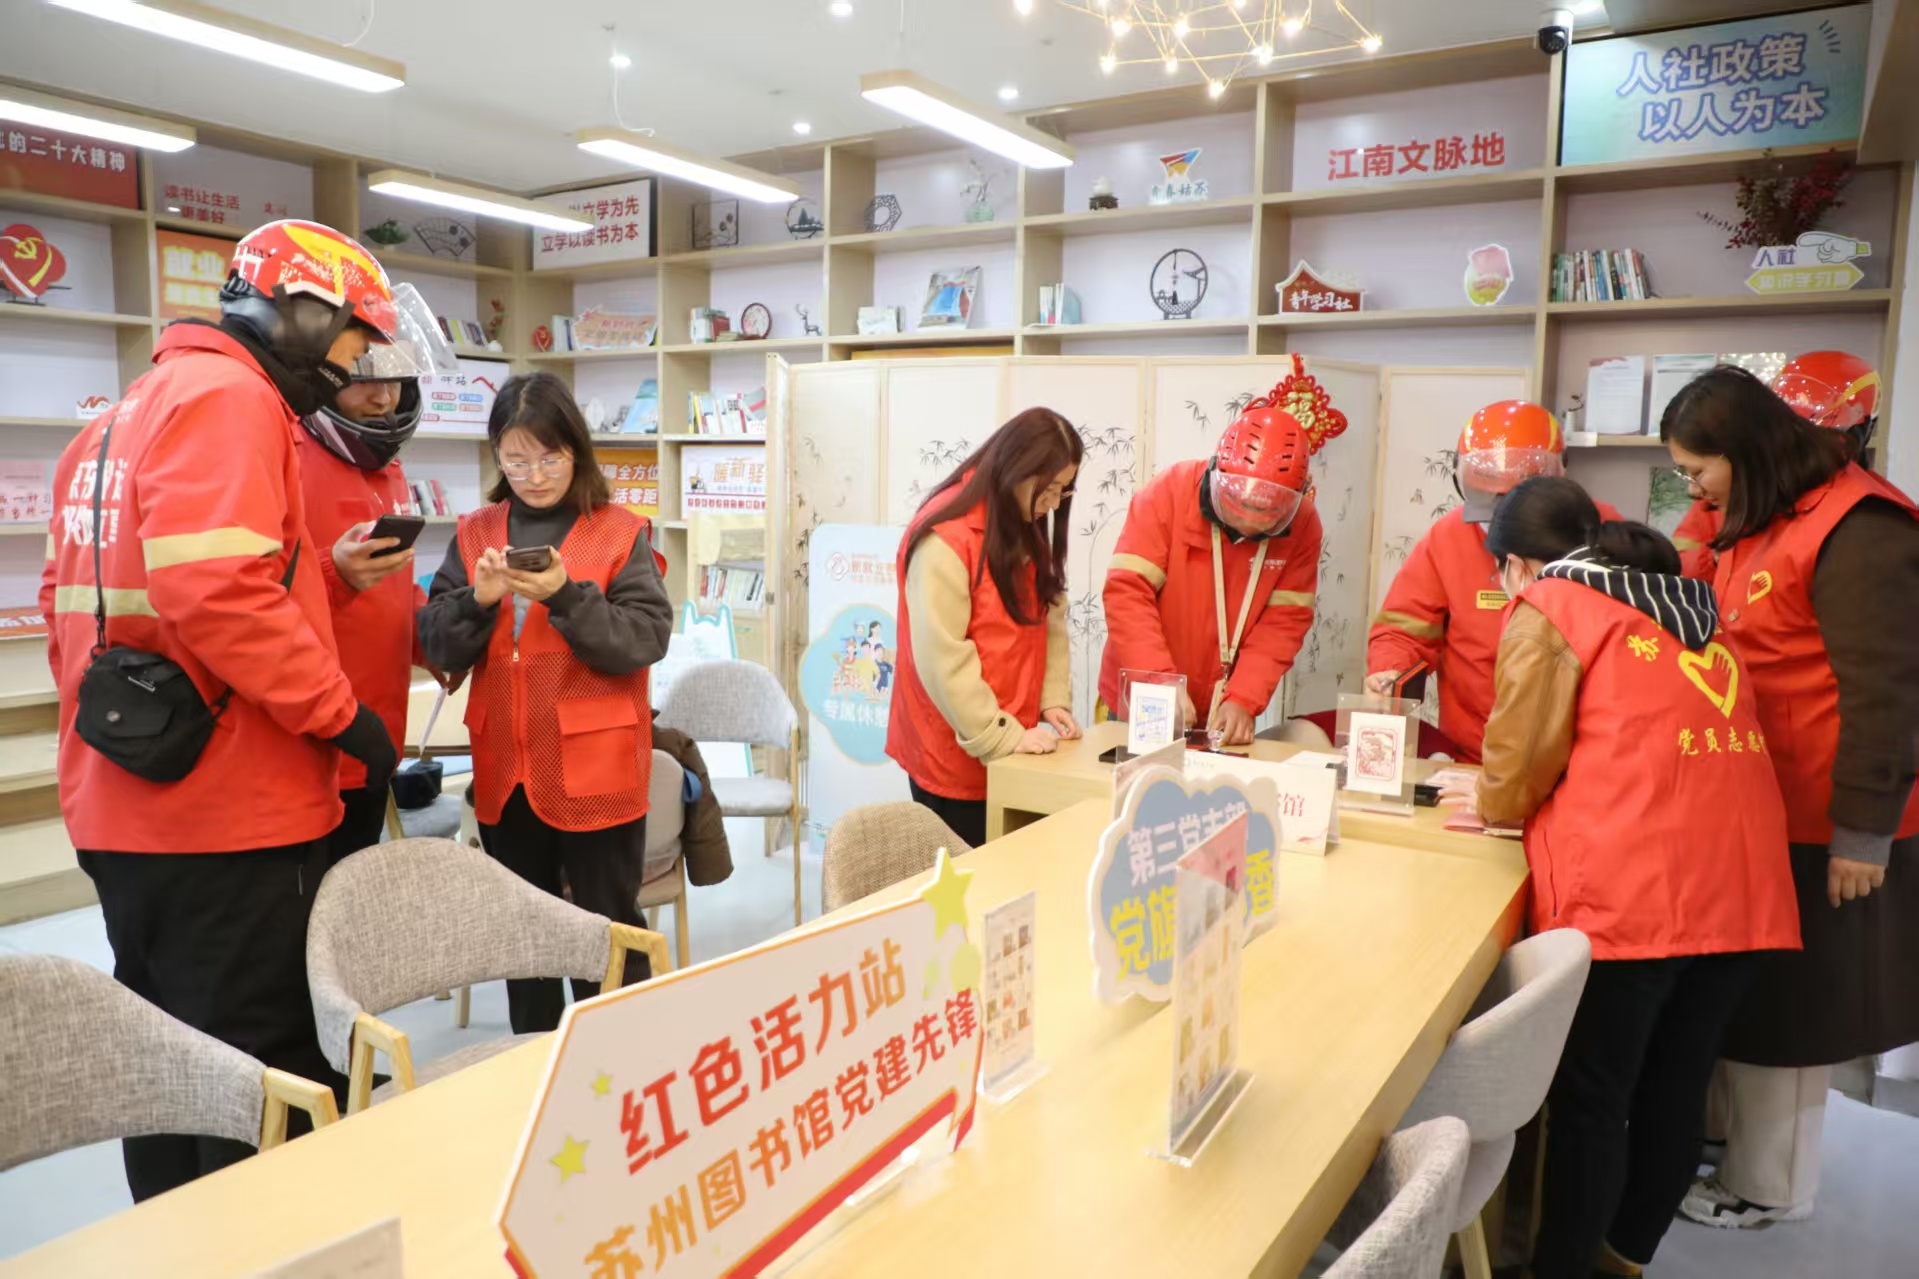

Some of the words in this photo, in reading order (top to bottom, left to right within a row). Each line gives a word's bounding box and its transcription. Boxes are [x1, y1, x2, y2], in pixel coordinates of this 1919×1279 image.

[1616, 33, 1807, 97] 人社政策
[1638, 82, 1828, 143] 以人为本
[1327, 131, 1505, 181] 江南文脉地
[164, 184, 240, 210] 读书让生活
[180, 205, 225, 224] 更美好
[541, 222, 640, 252] 立学以读书为本
[1756, 248, 1797, 267] 人社
[1289, 288, 1354, 312] 青年学习社
[619, 938, 907, 1176] 红色活力站
[583, 987, 979, 1279] 苏州图书馆党建先锋
